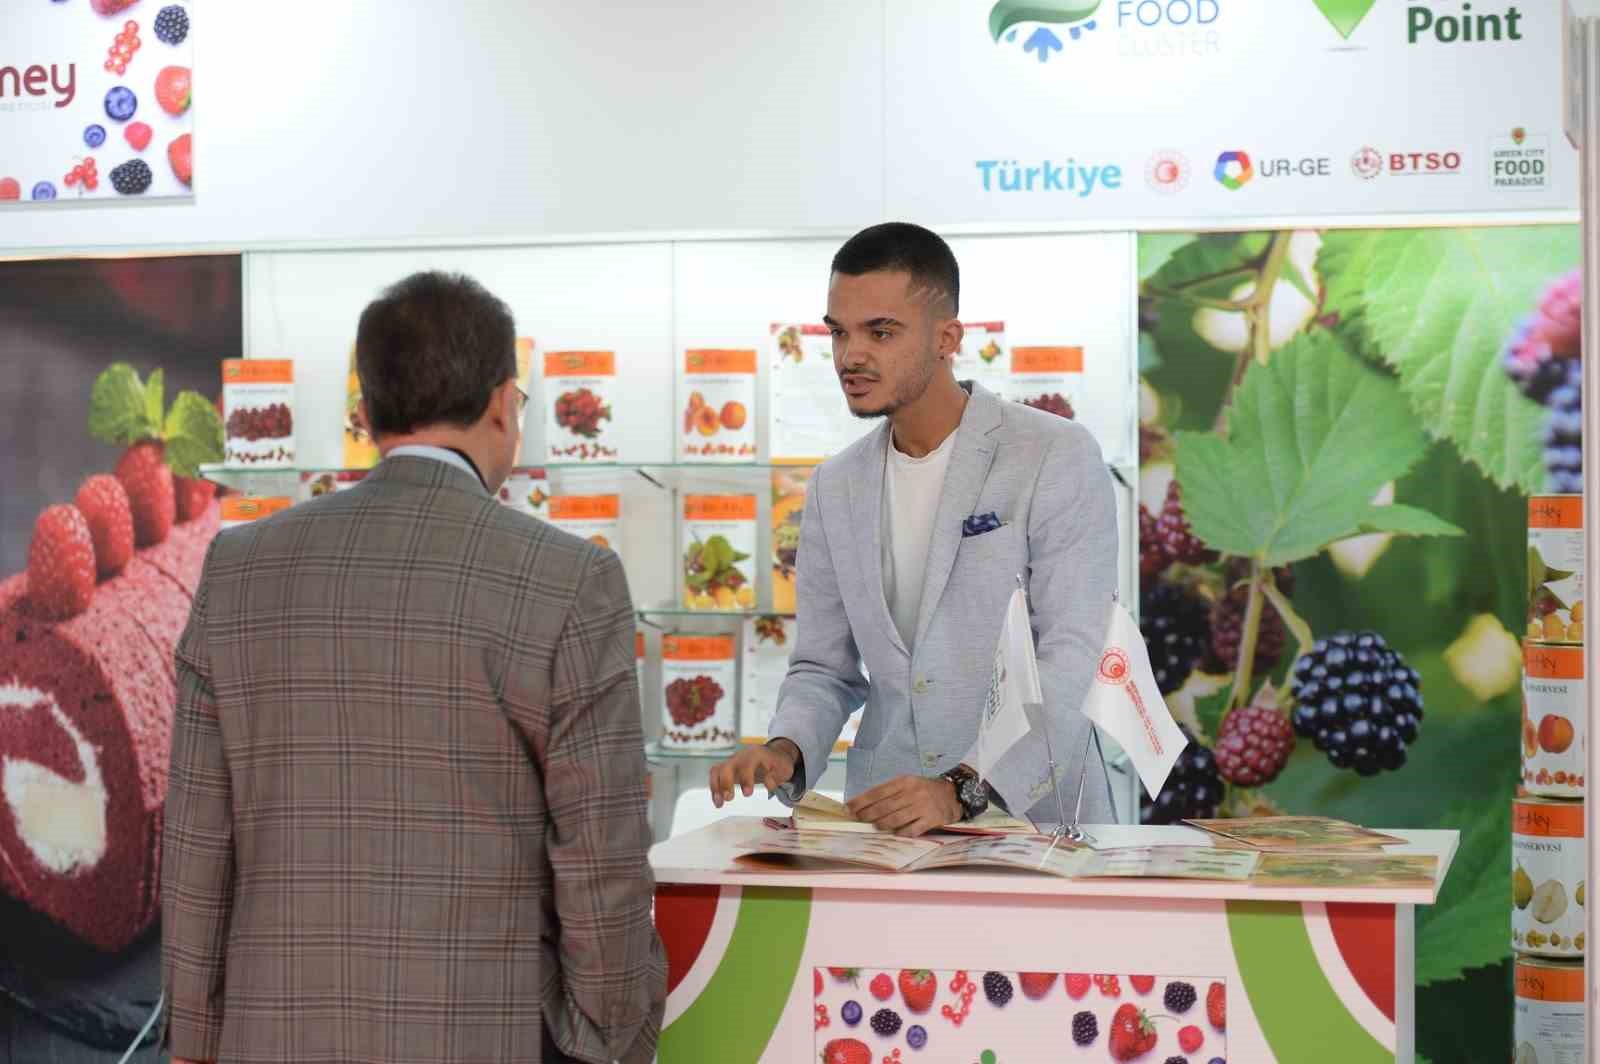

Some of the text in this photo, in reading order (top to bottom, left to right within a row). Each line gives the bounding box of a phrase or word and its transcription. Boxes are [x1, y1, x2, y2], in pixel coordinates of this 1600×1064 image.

[1117, 0, 1220, 28] FOOD
[1407, 3, 1523, 44] Point
[1260, 158, 1331, 177] UR-GE
[1389, 152, 1461, 171] BTSO
[1494, 160, 1545, 175] FOOD
[975, 158, 1123, 197] Türkiye
